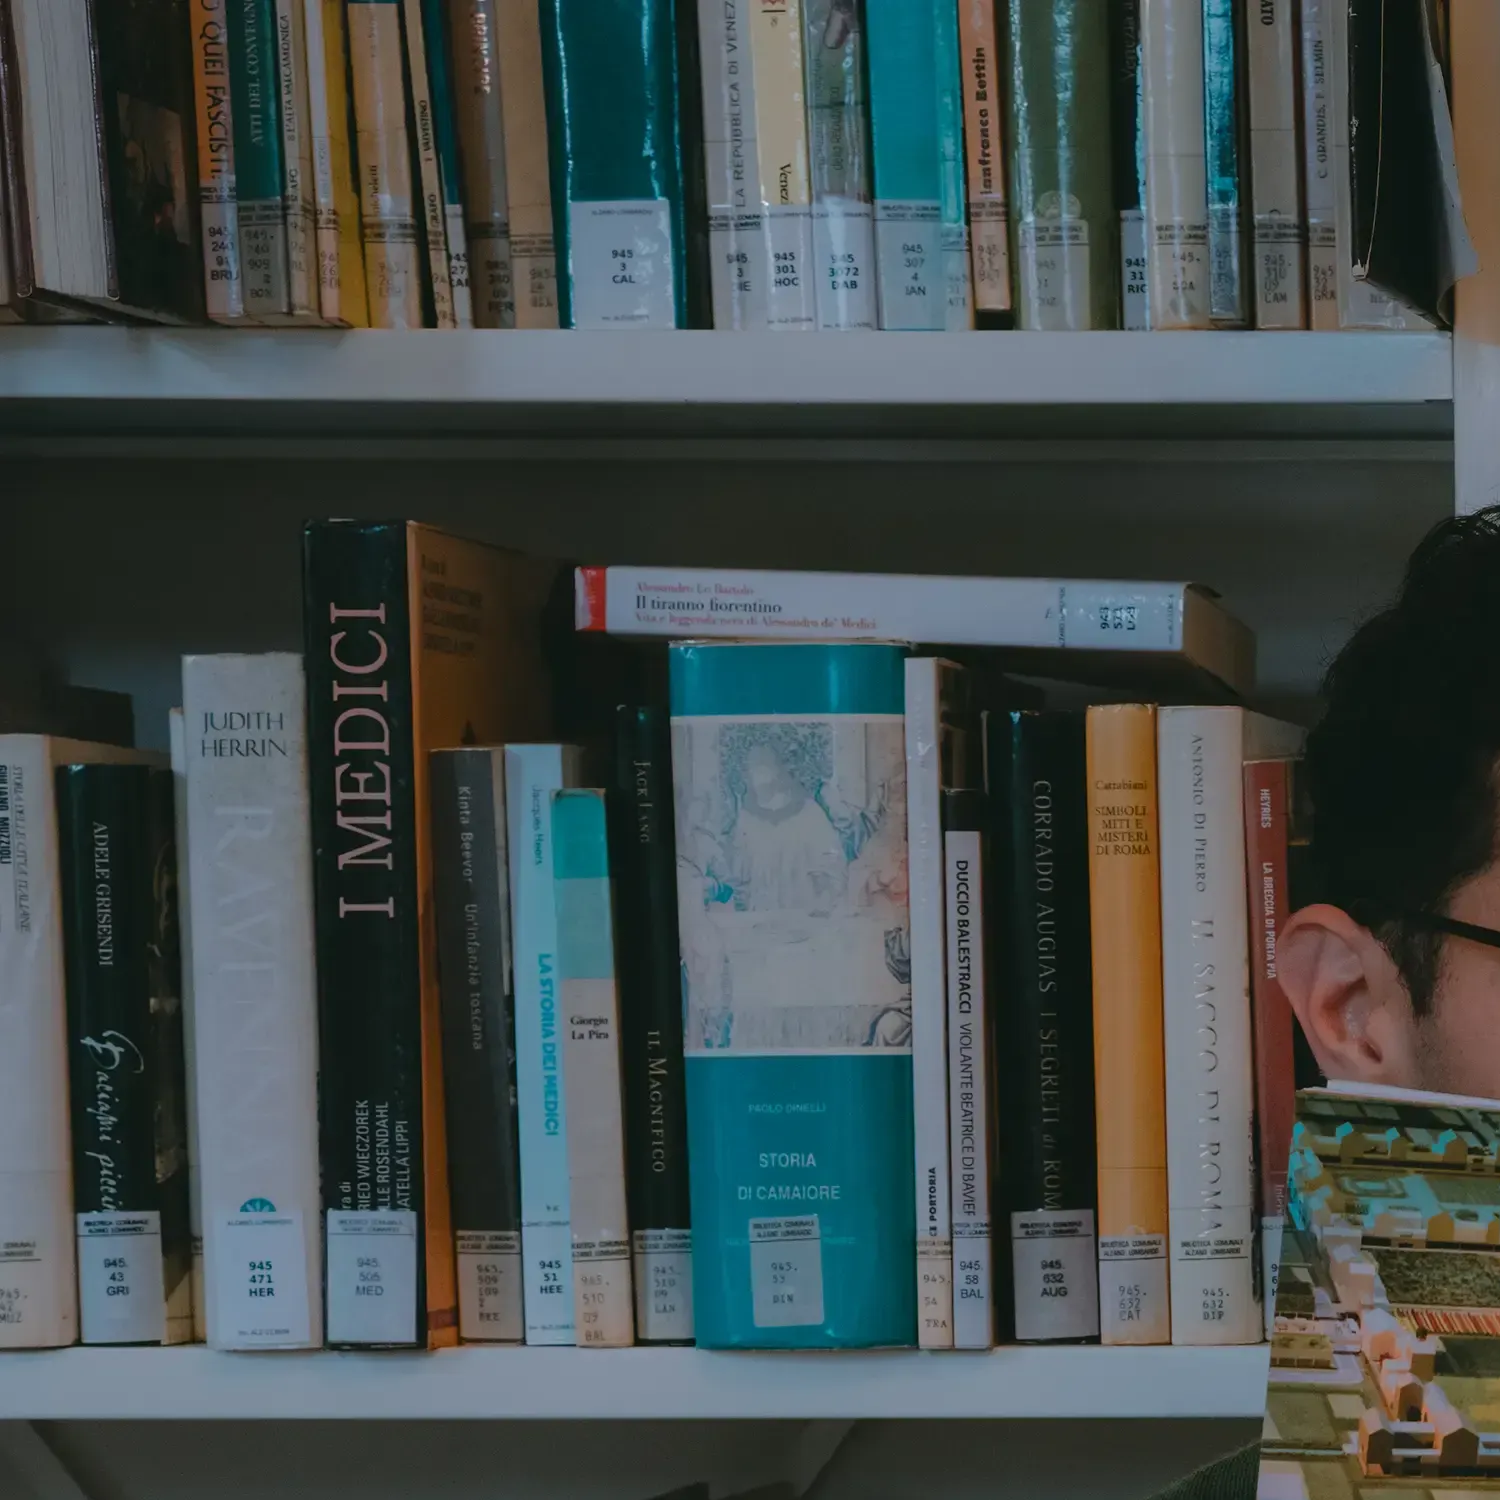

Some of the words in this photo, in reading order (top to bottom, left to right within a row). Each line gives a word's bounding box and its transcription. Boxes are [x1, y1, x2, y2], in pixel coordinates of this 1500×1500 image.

[726, 59, 738, 76] DI
[726, 82, 743, 181] REPUBBLICA
[733, 187, 745, 208] LA
[611, 248, 634, 258] 945
[620, 262, 626, 270] 3
[611, 274, 635, 284] CAL
[635, 596, 646, 613] Il
[651, 596, 705, 613] tiranno
[708, 596, 783, 615] fiorentino
[201, 710, 285, 732] JUDITH
[200, 737, 289, 758] HERRIN
[328, 600, 394, 874] MEDICI
[93, 821, 110, 879] ADELE
[957, 859, 972, 917] DUCCIO
[339, 897, 397, 920] I
[95, 884, 114, 967] GRISENDI
[538, 953, 553, 974] LA
[958, 917, 974, 1015] BALESTRACCI
[213, 804, 291, 1181] RAVENNA
[539, 976, 555, 1039] STORIA
[542, 1042, 558, 1071] DEI
[960, 1022, 977, 1090] VIOLANTE
[543, 1075, 560, 1136] MEDICI
[962, 1091, 979, 1155] BEATRICE
[757, 1152, 818, 1169] STORIA
[963, 1156, 979, 1172] DI
[737, 1185, 752, 1201] DI
[755, 1183, 842, 1202] CAMAIORE
[248, 1260, 274, 1272] 945
[248, 1273, 274, 1285] 471
[248, 1286, 276, 1298] HER
